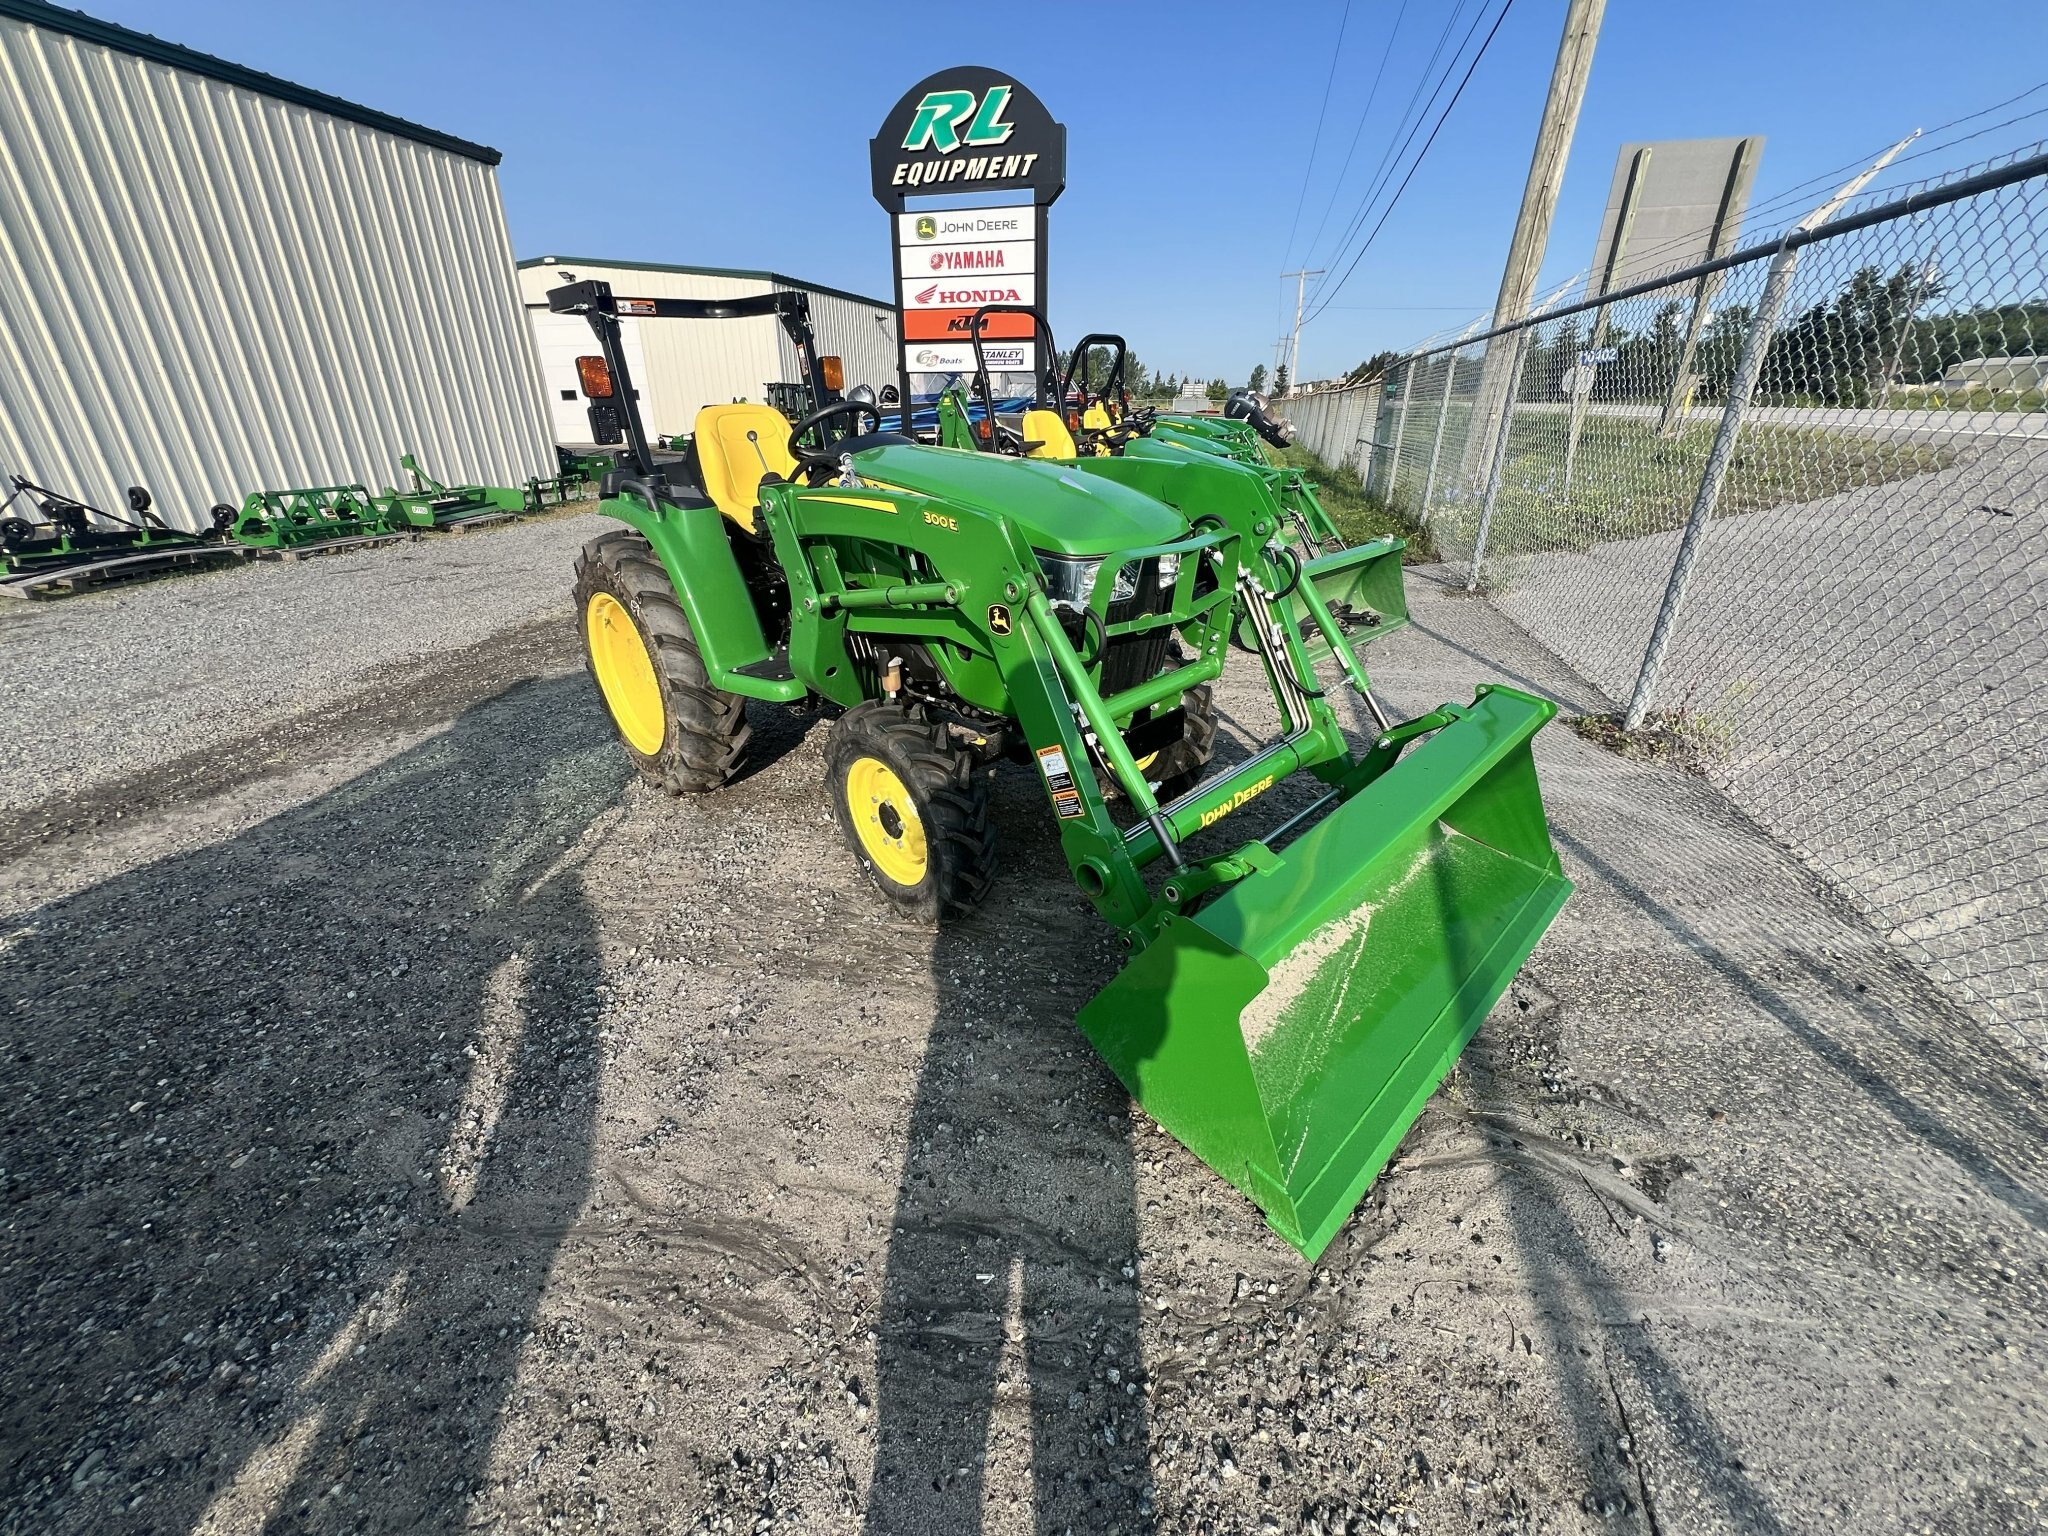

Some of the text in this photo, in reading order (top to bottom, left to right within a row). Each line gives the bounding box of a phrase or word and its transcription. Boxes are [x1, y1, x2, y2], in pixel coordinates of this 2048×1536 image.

[901, 85, 1014, 154] RL
[892, 154, 1038, 186] EQUIPMENT
[940, 219, 1018, 233] JOHN DEERE
[945, 250, 1004, 269] YAMAHA
[939, 289, 1021, 303] HONDA
[1198, 775, 1273, 830] JOHN DEERE
